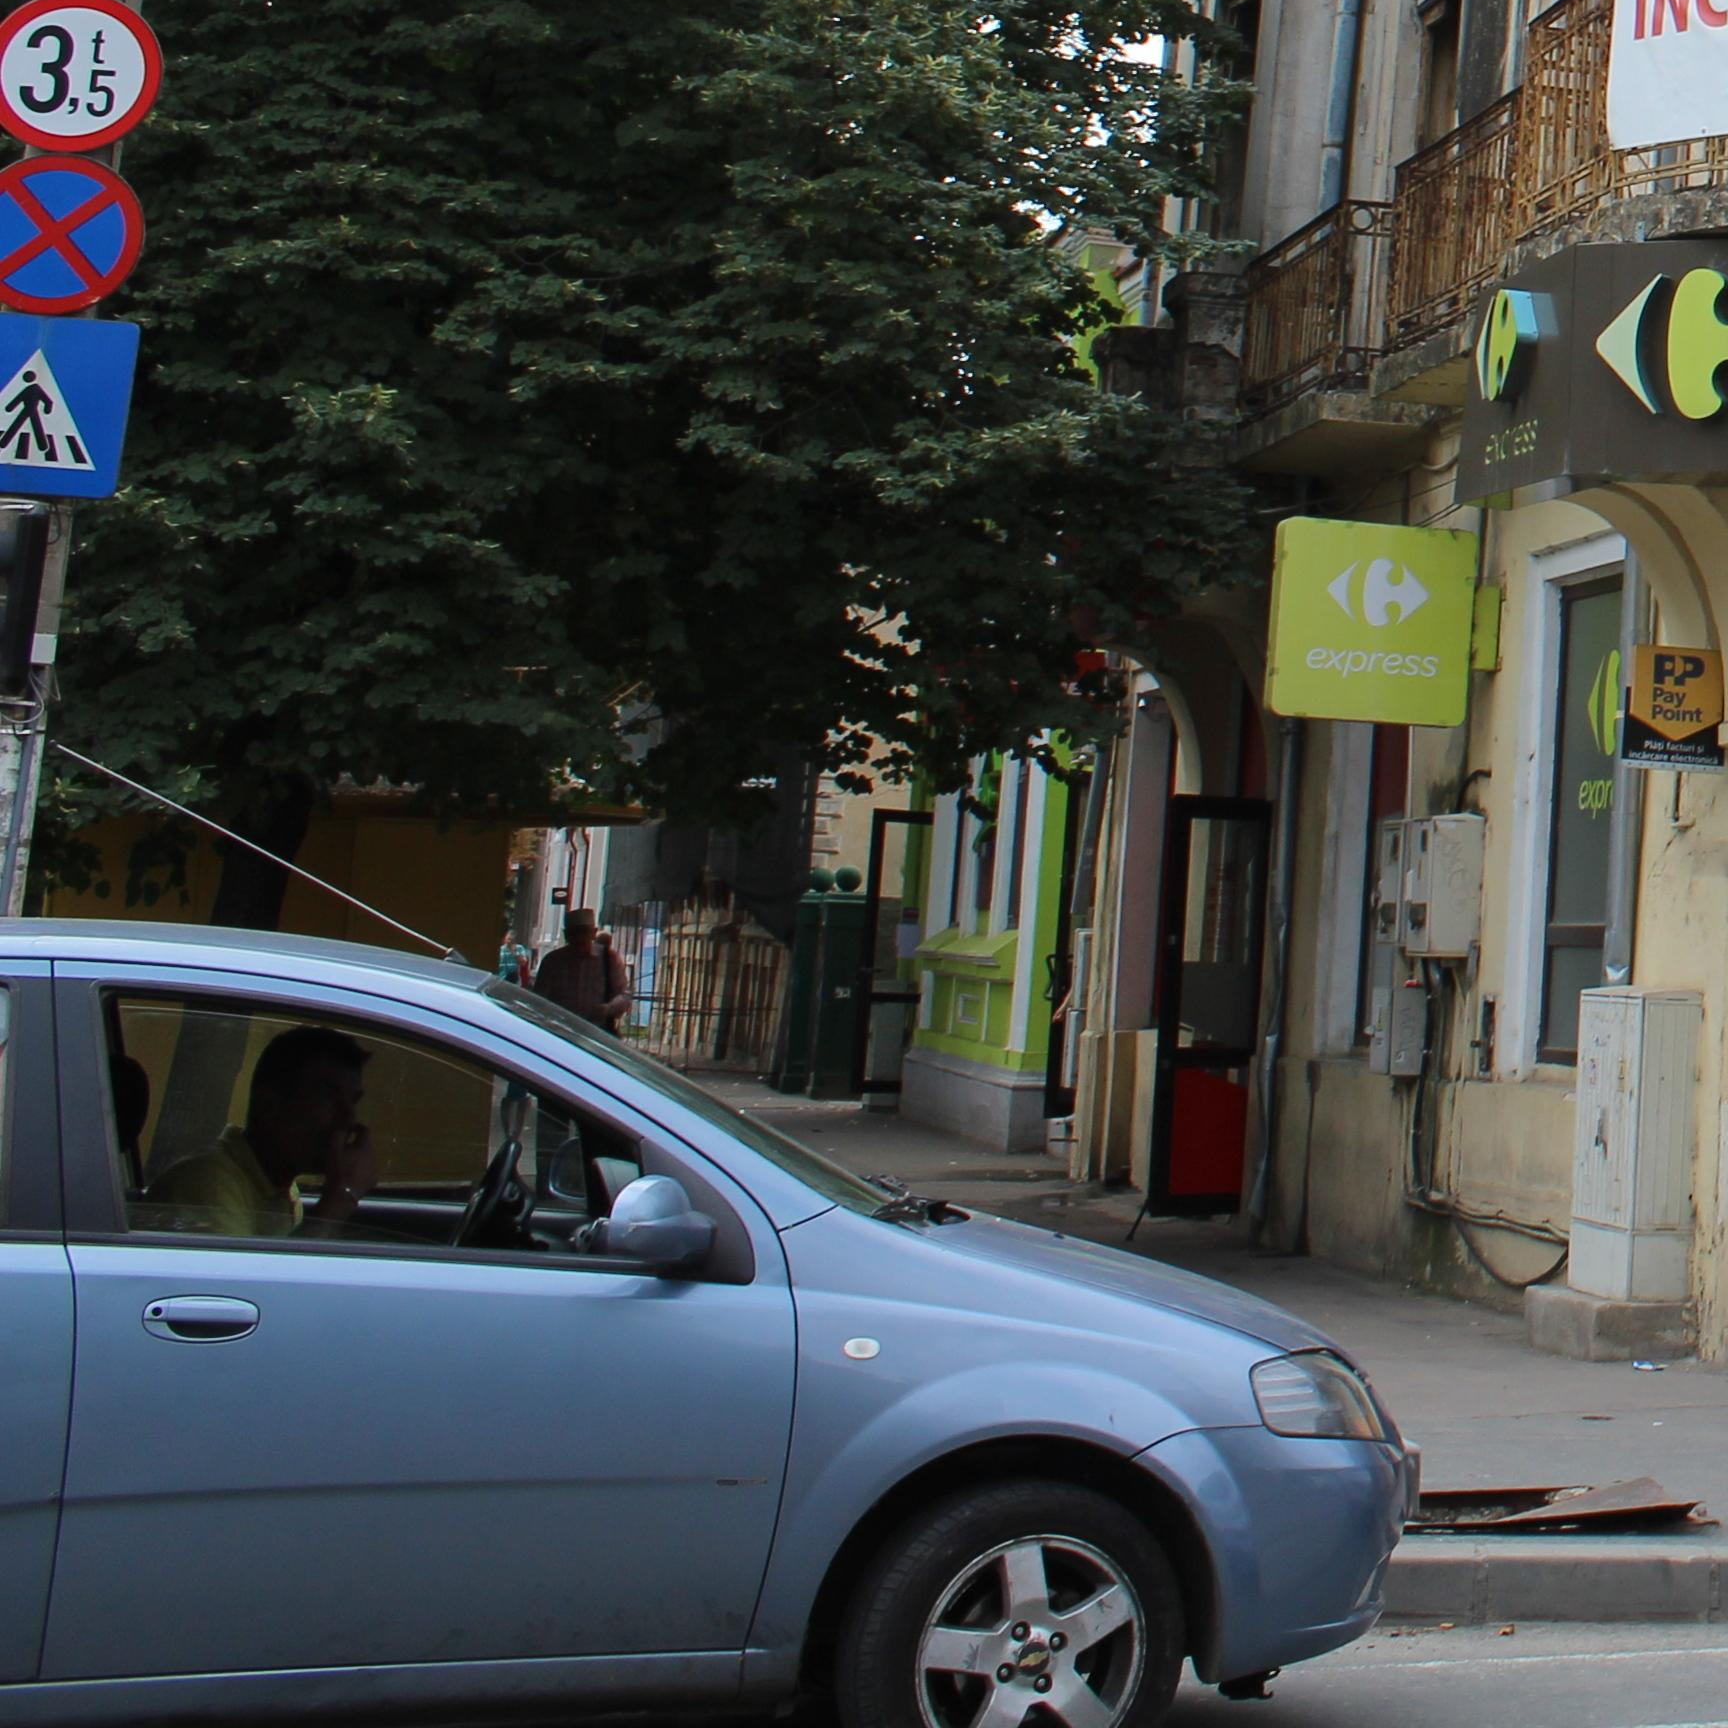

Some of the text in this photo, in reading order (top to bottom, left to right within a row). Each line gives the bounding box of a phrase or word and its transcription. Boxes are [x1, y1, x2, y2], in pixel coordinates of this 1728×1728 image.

[1305, 646, 1440, 679] express
[1652, 686, 1686, 708] Pay
[1651, 703, 1703, 723] Point
